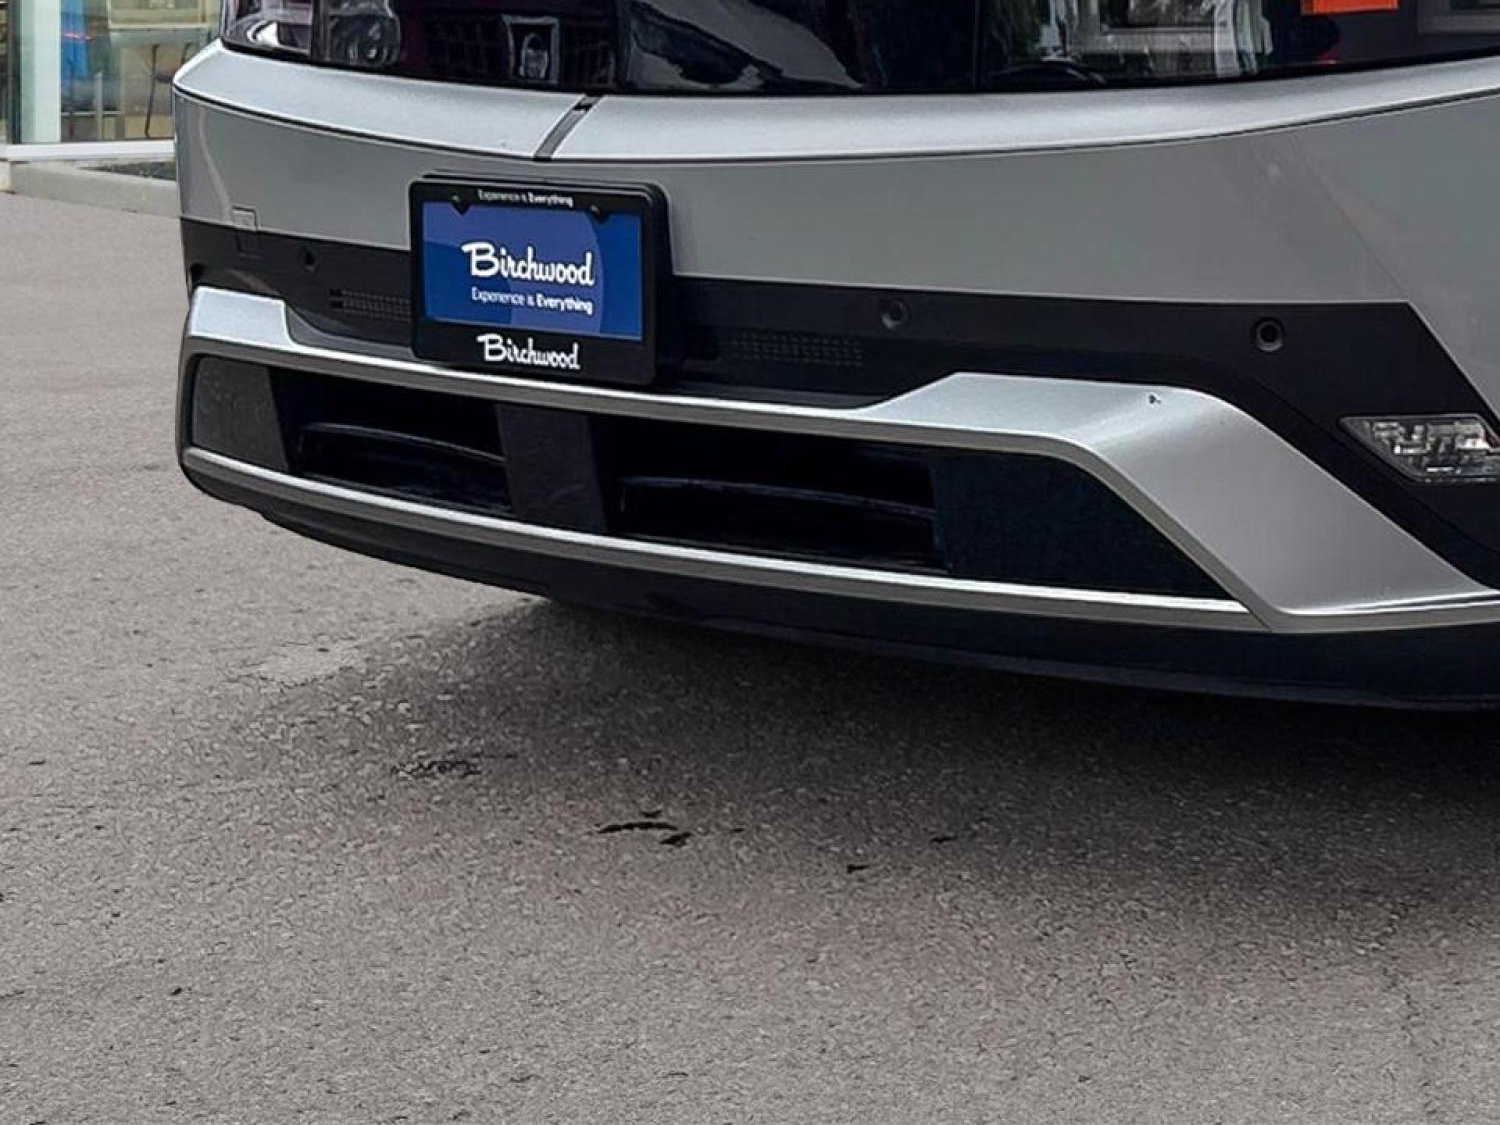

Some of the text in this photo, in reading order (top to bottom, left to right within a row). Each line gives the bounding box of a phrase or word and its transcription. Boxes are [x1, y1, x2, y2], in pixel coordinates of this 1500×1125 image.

[527, 192, 574, 208] Everything
[461, 241, 595, 286] Birchwood
[471, 287, 525, 305] Experience
[536, 293, 593, 315] Everything
[477, 333, 581, 369] Birchwood
